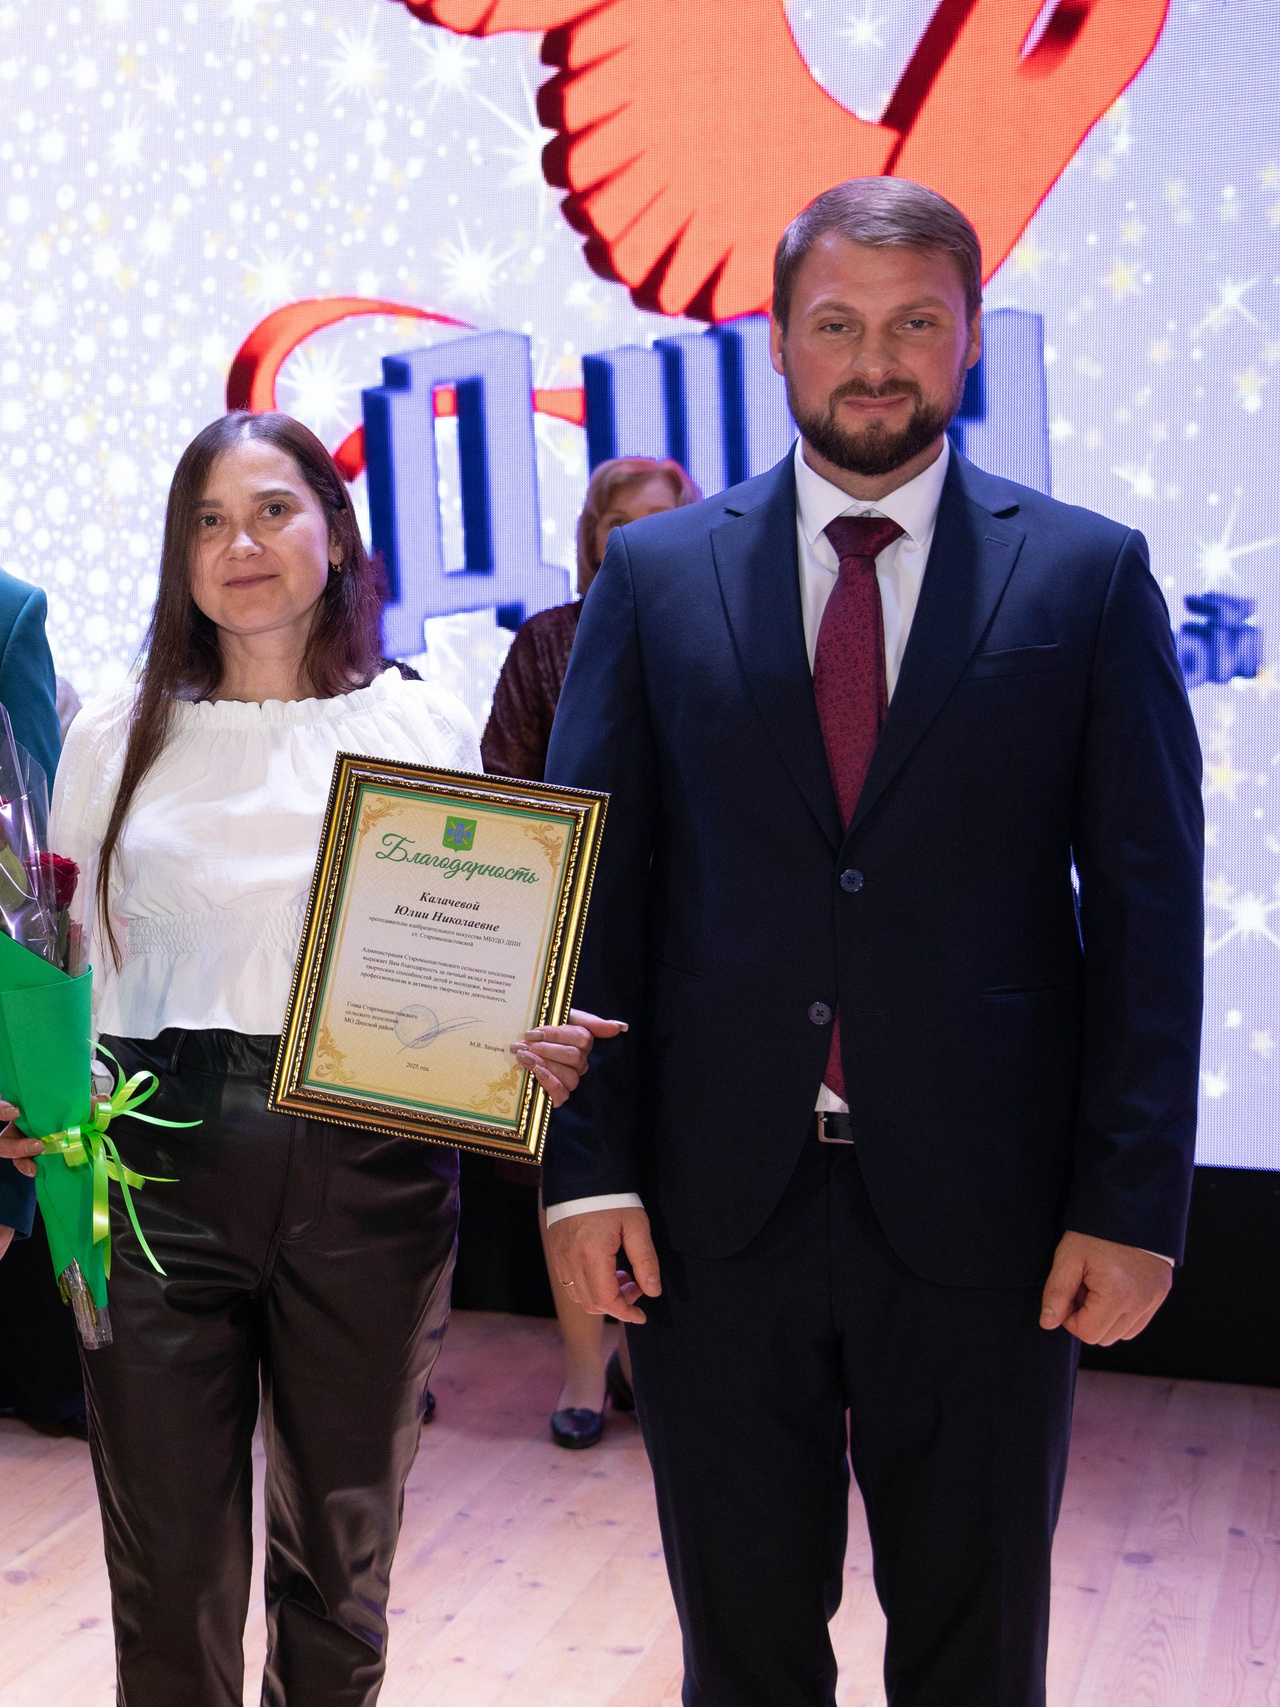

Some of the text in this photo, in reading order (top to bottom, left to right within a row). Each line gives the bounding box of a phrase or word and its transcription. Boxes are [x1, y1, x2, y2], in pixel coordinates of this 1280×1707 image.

[375, 833, 540, 884] Благодарность
[419, 891, 480, 911] Калачевой
[394, 905, 500, 932] Юлии Николаевне
[368, 916, 408, 927] преподавателю
[408, 923, 456, 936] изобразительного
[456, 931, 482, 940] искусства
[482, 935, 505, 945] МБУДО
[419, 933, 474, 947] Старомышастовской
[361, 947, 516, 979] Администрация Старомышастовского сельского поселения
[362, 956, 388, 965] выражает
[400, 961, 438, 974] благодарность
[467, 974, 482, 982] вклад
[488, 978, 512, 987] развитие
[360, 971, 407, 985] профессионализм
[412, 982, 438, 991] активную
[439, 986, 470, 997] творческую
[470, 992, 507, 1003] деятельность.
[366, 964, 395, 974] творческих
[396, 970, 432, 981] способностей
[433, 976, 448, 984] детей
[482, 986, 506, 994] высокий
[346, 1001, 361, 1009] Глава
[345, 1010, 399, 1024] сельского поселения
[354, 1019, 378, 1028] Динской
[484, 1043, 505, 1053] Захаров
[406, 1061, 419, 1069] 2025
